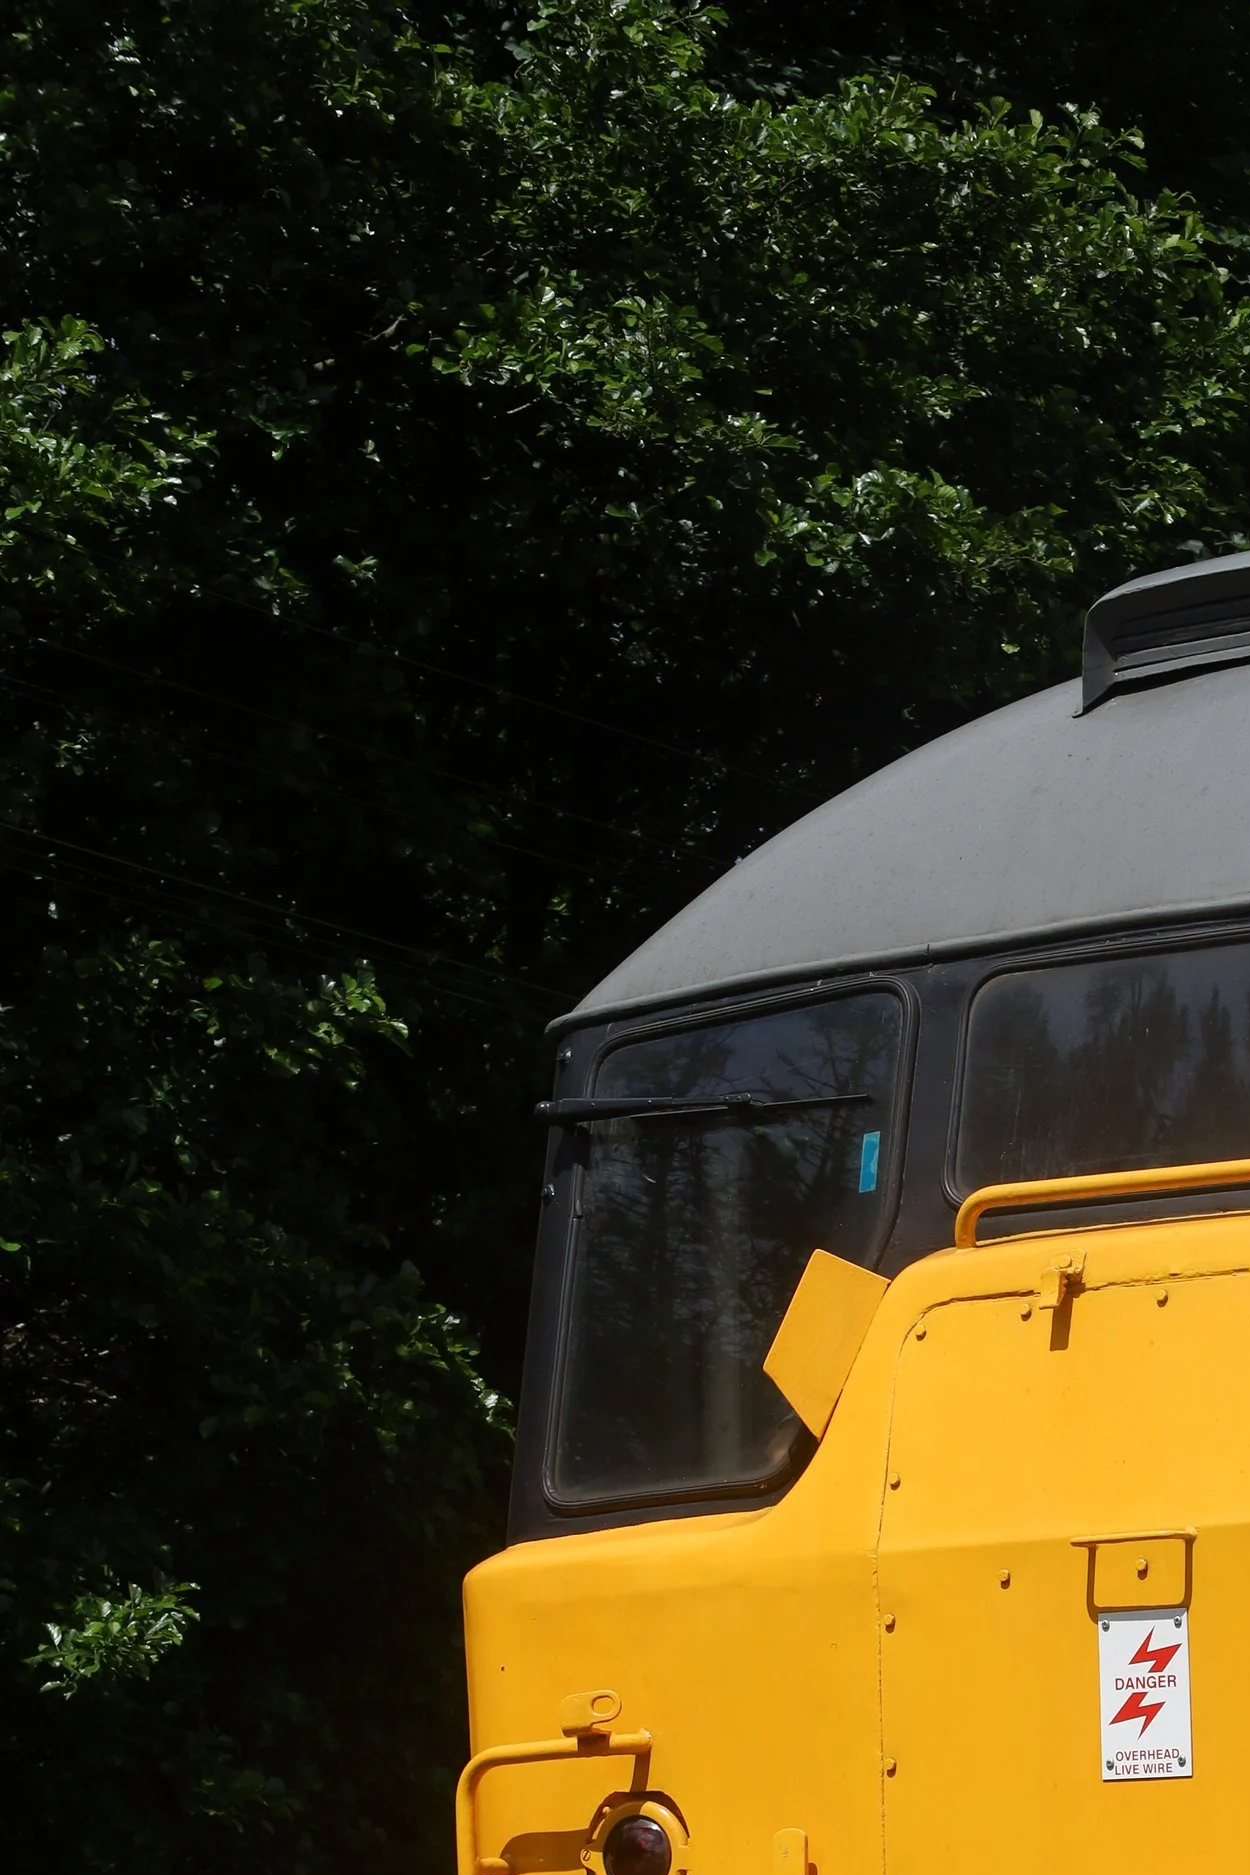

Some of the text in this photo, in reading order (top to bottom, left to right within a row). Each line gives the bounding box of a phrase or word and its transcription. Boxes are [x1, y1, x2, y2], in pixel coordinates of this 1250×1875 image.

[1115, 1674, 1177, 1691] DANGER
[1115, 1748, 1180, 1762] OVERHEAD
[1115, 1762, 1173, 1776] LIVE WIRE
